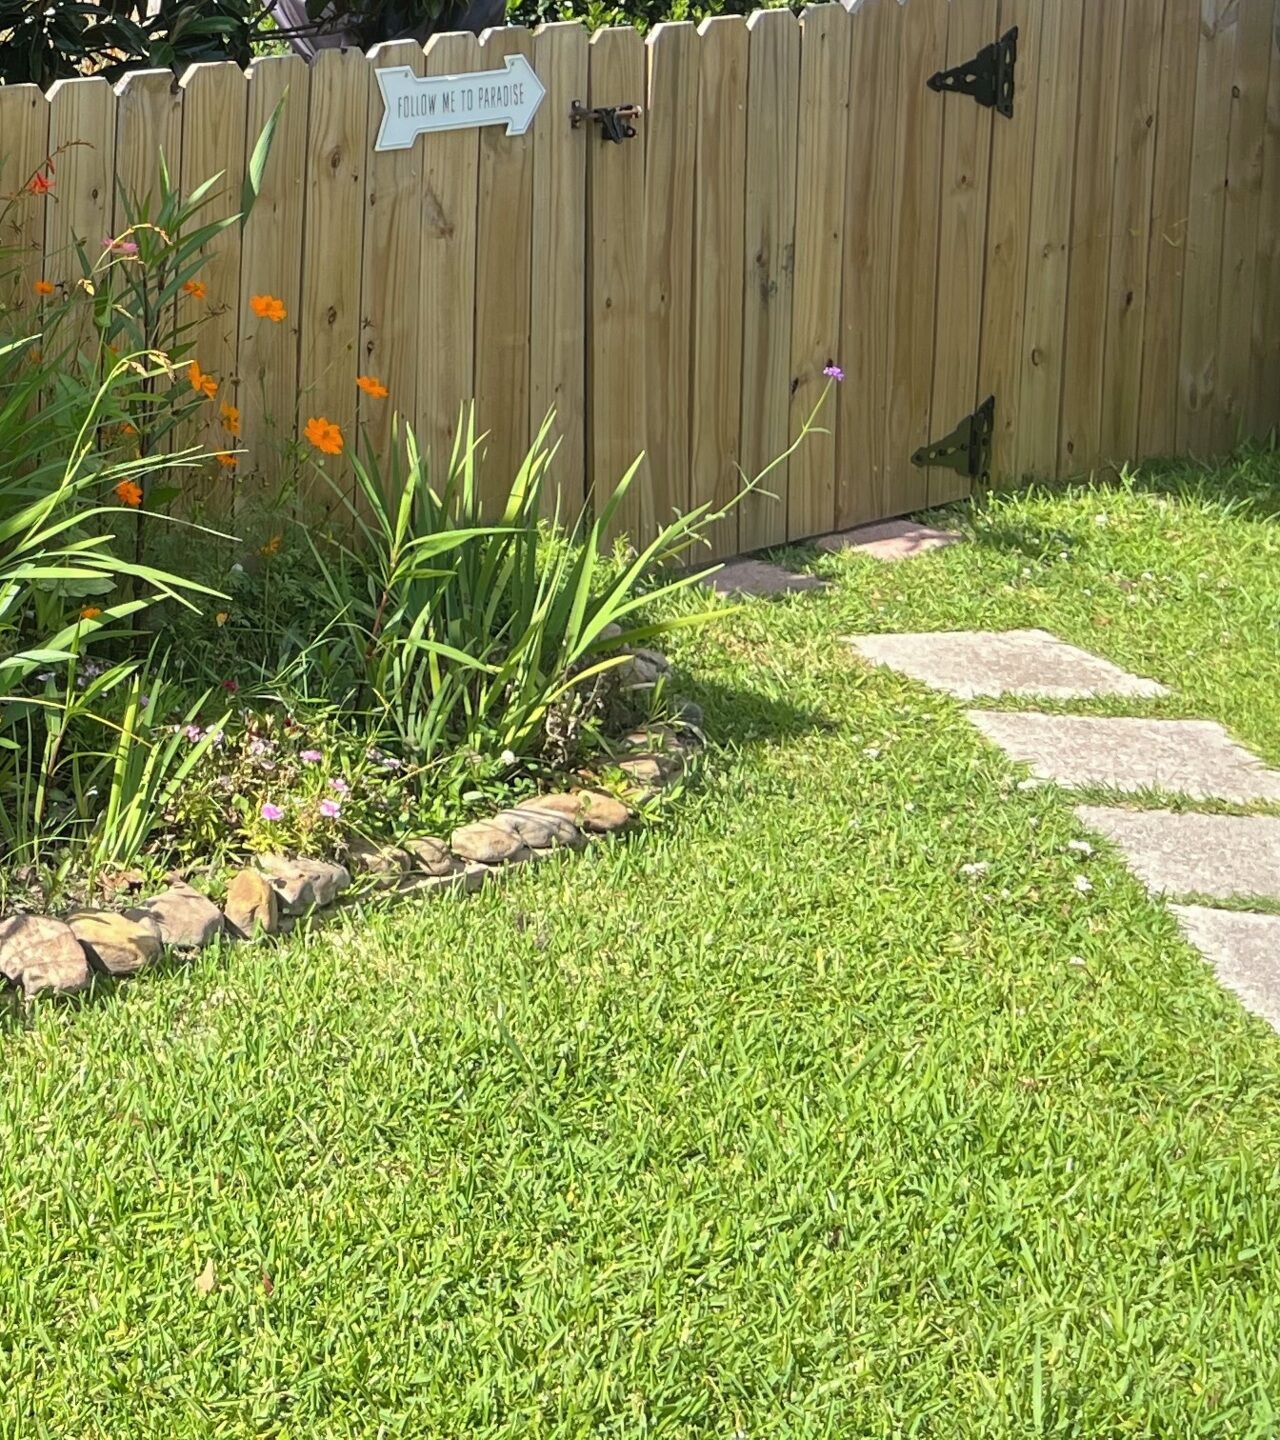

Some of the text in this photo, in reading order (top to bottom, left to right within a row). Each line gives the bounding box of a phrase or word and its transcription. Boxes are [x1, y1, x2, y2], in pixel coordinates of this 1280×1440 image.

[398, 83, 524, 118] FOLLOW ME TO PARADISE
